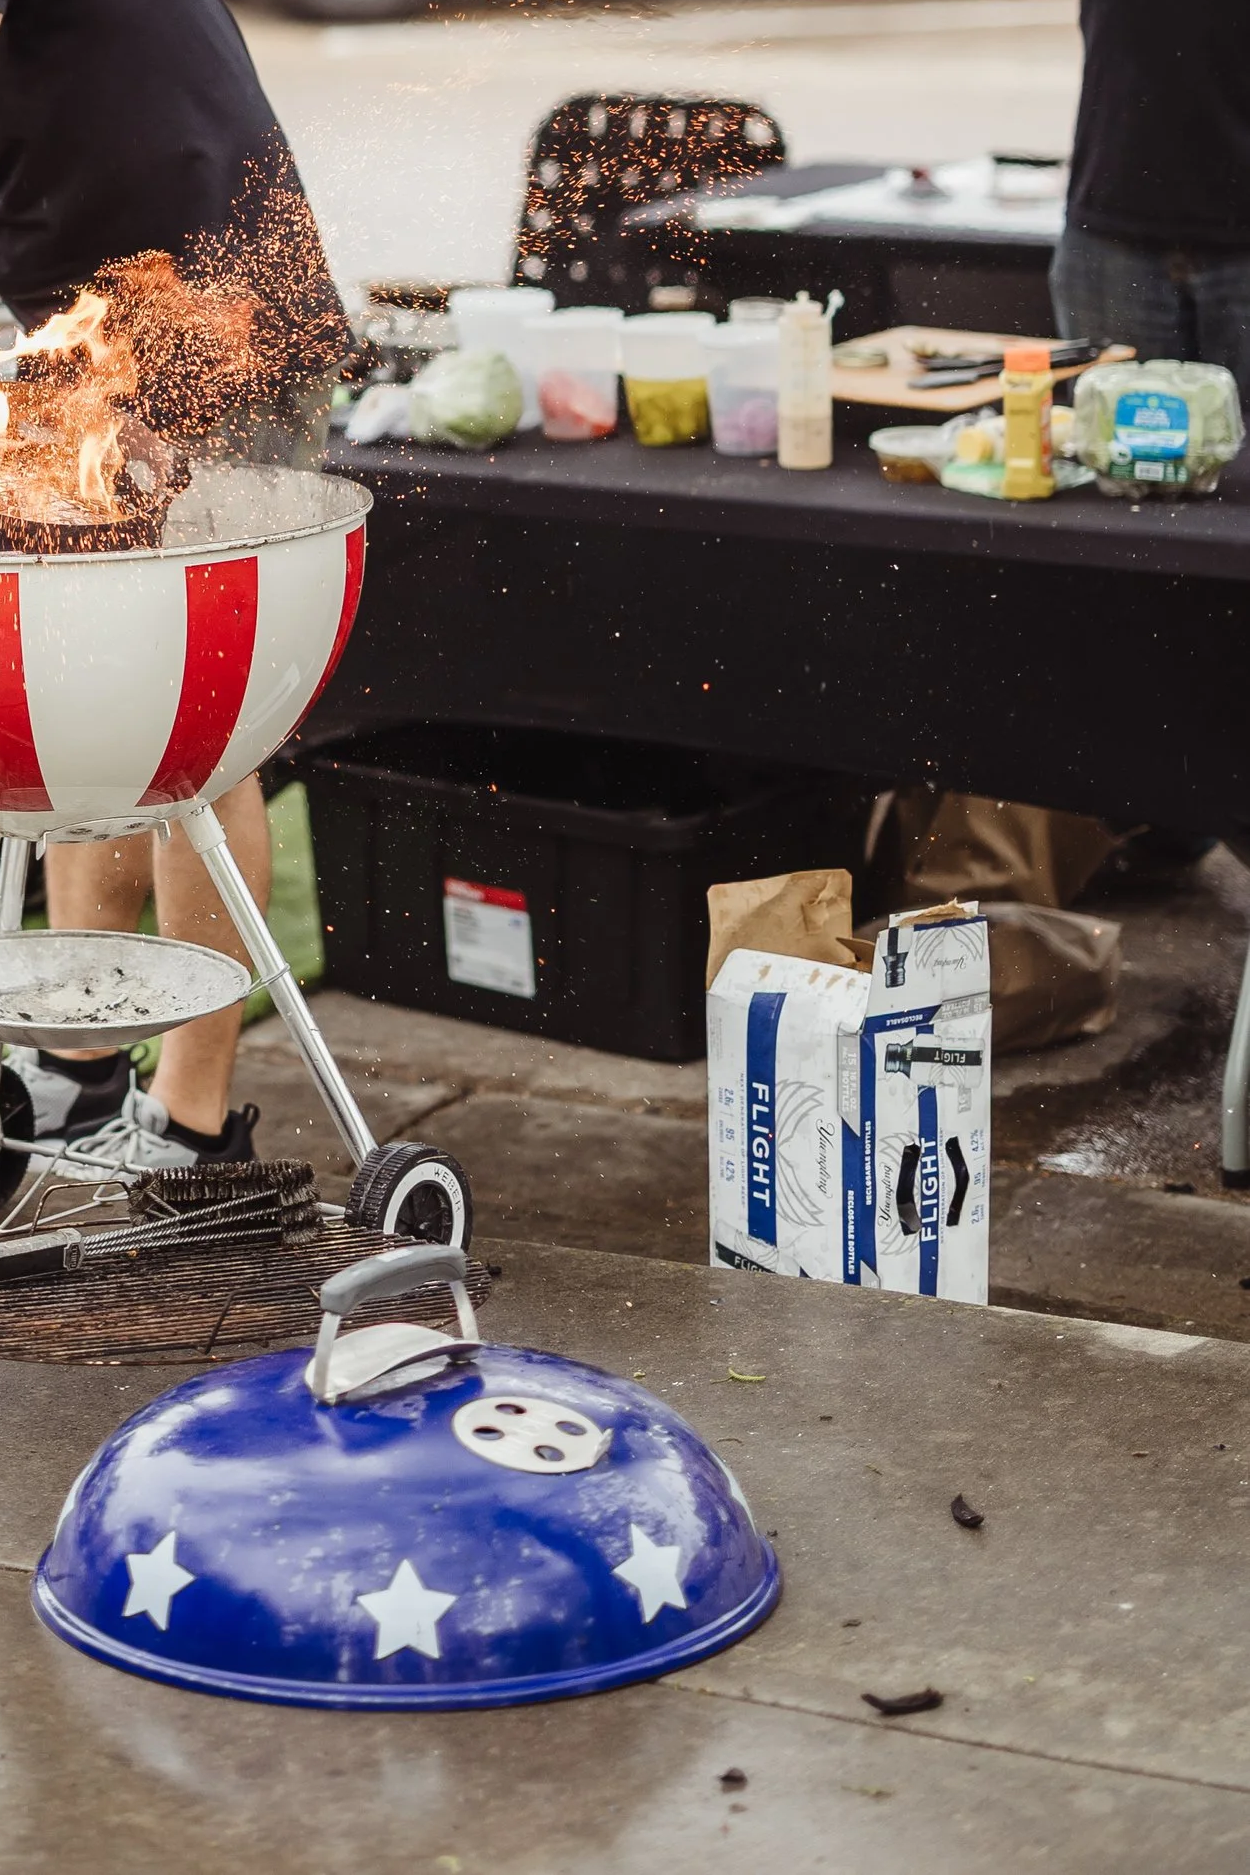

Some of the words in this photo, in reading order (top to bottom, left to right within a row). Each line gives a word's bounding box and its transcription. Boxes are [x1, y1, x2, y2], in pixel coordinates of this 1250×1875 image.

[885, 1013, 924, 1026] RECLOSABLE
[847, 1052, 857, 1066] 15
[933, 1050, 967, 1064] FLIGT
[841, 1070, 850, 1113] BOTTLES
[725, 1127, 736, 1141] 95
[751, 1081, 771, 1208] FLIGHT
[970, 1129, 980, 1153] 4.2%
[725, 1159, 736, 1183] 4.2%
[815, 1118, 836, 1199] Yuengling
[433, 1166, 462, 1214] WEBER
[878, 1161, 895, 1227] Yuengling
[921, 1137, 939, 1242] FLIGHT
[847, 1189, 855, 1239] RECLOSABLE
[848, 1240, 856, 1275] BOTTLES
